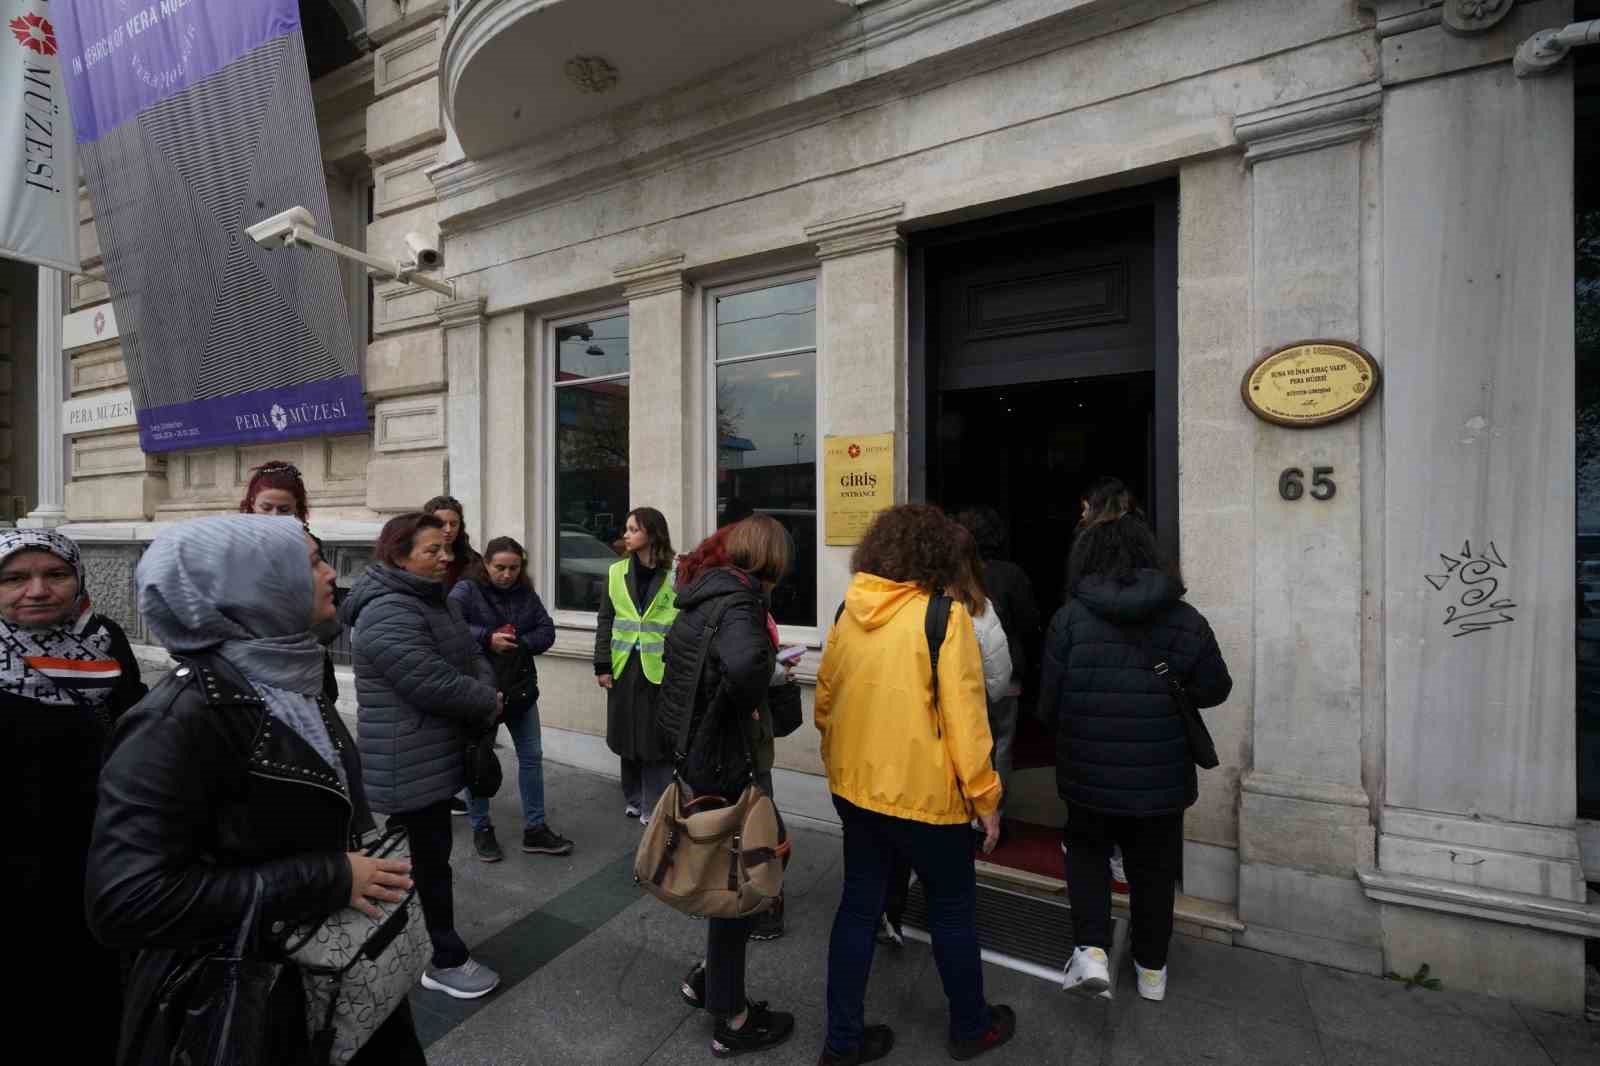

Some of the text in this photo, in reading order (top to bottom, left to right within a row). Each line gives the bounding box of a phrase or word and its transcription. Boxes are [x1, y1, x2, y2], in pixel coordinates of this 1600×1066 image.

[125, 7, 159, 38] VERA
[24, 61, 61, 193] MÜZESİ
[70, 407, 94, 424] PERA
[235, 397, 347, 432] PERA MÜZESİ
[840, 471, 877, 489] GİRİŞ
[1278, 466, 1337, 501] 65
